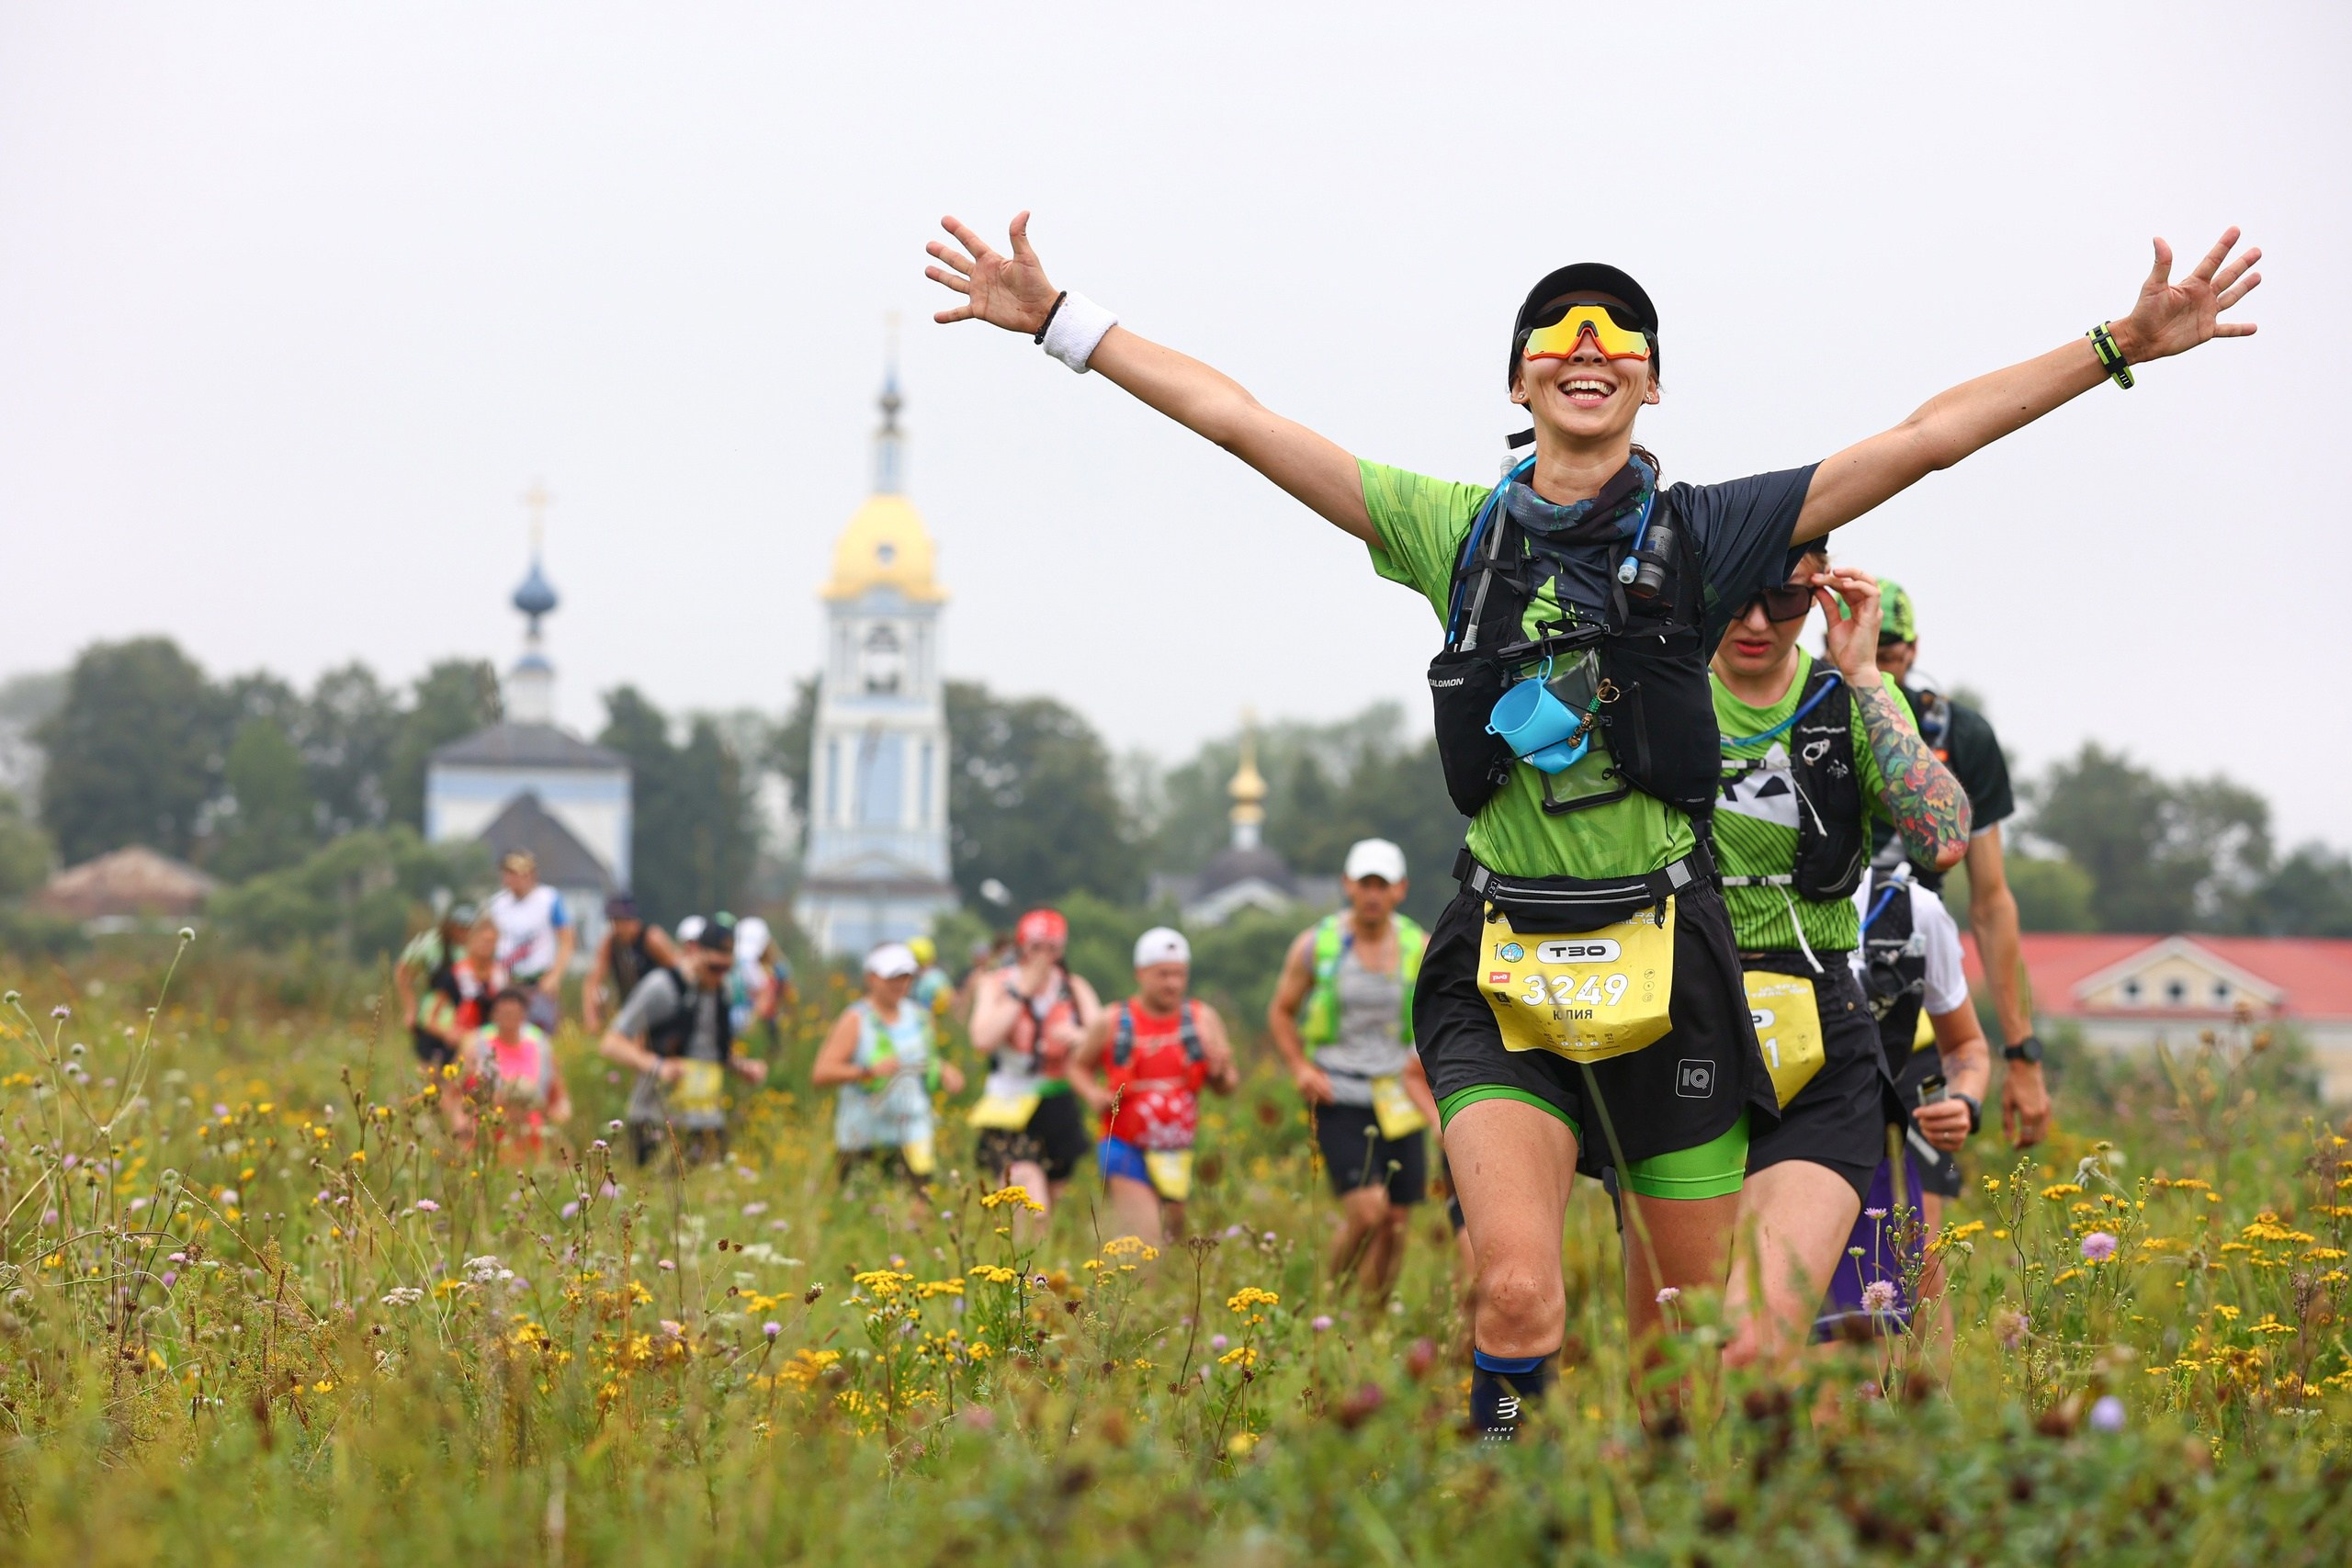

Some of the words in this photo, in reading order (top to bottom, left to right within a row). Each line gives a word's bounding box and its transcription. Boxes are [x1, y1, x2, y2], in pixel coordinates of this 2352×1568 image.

[1549, 946, 1606, 957] T30
[1521, 973, 1629, 1007] 3249
[1681, 1067, 1710, 1090] IQ
